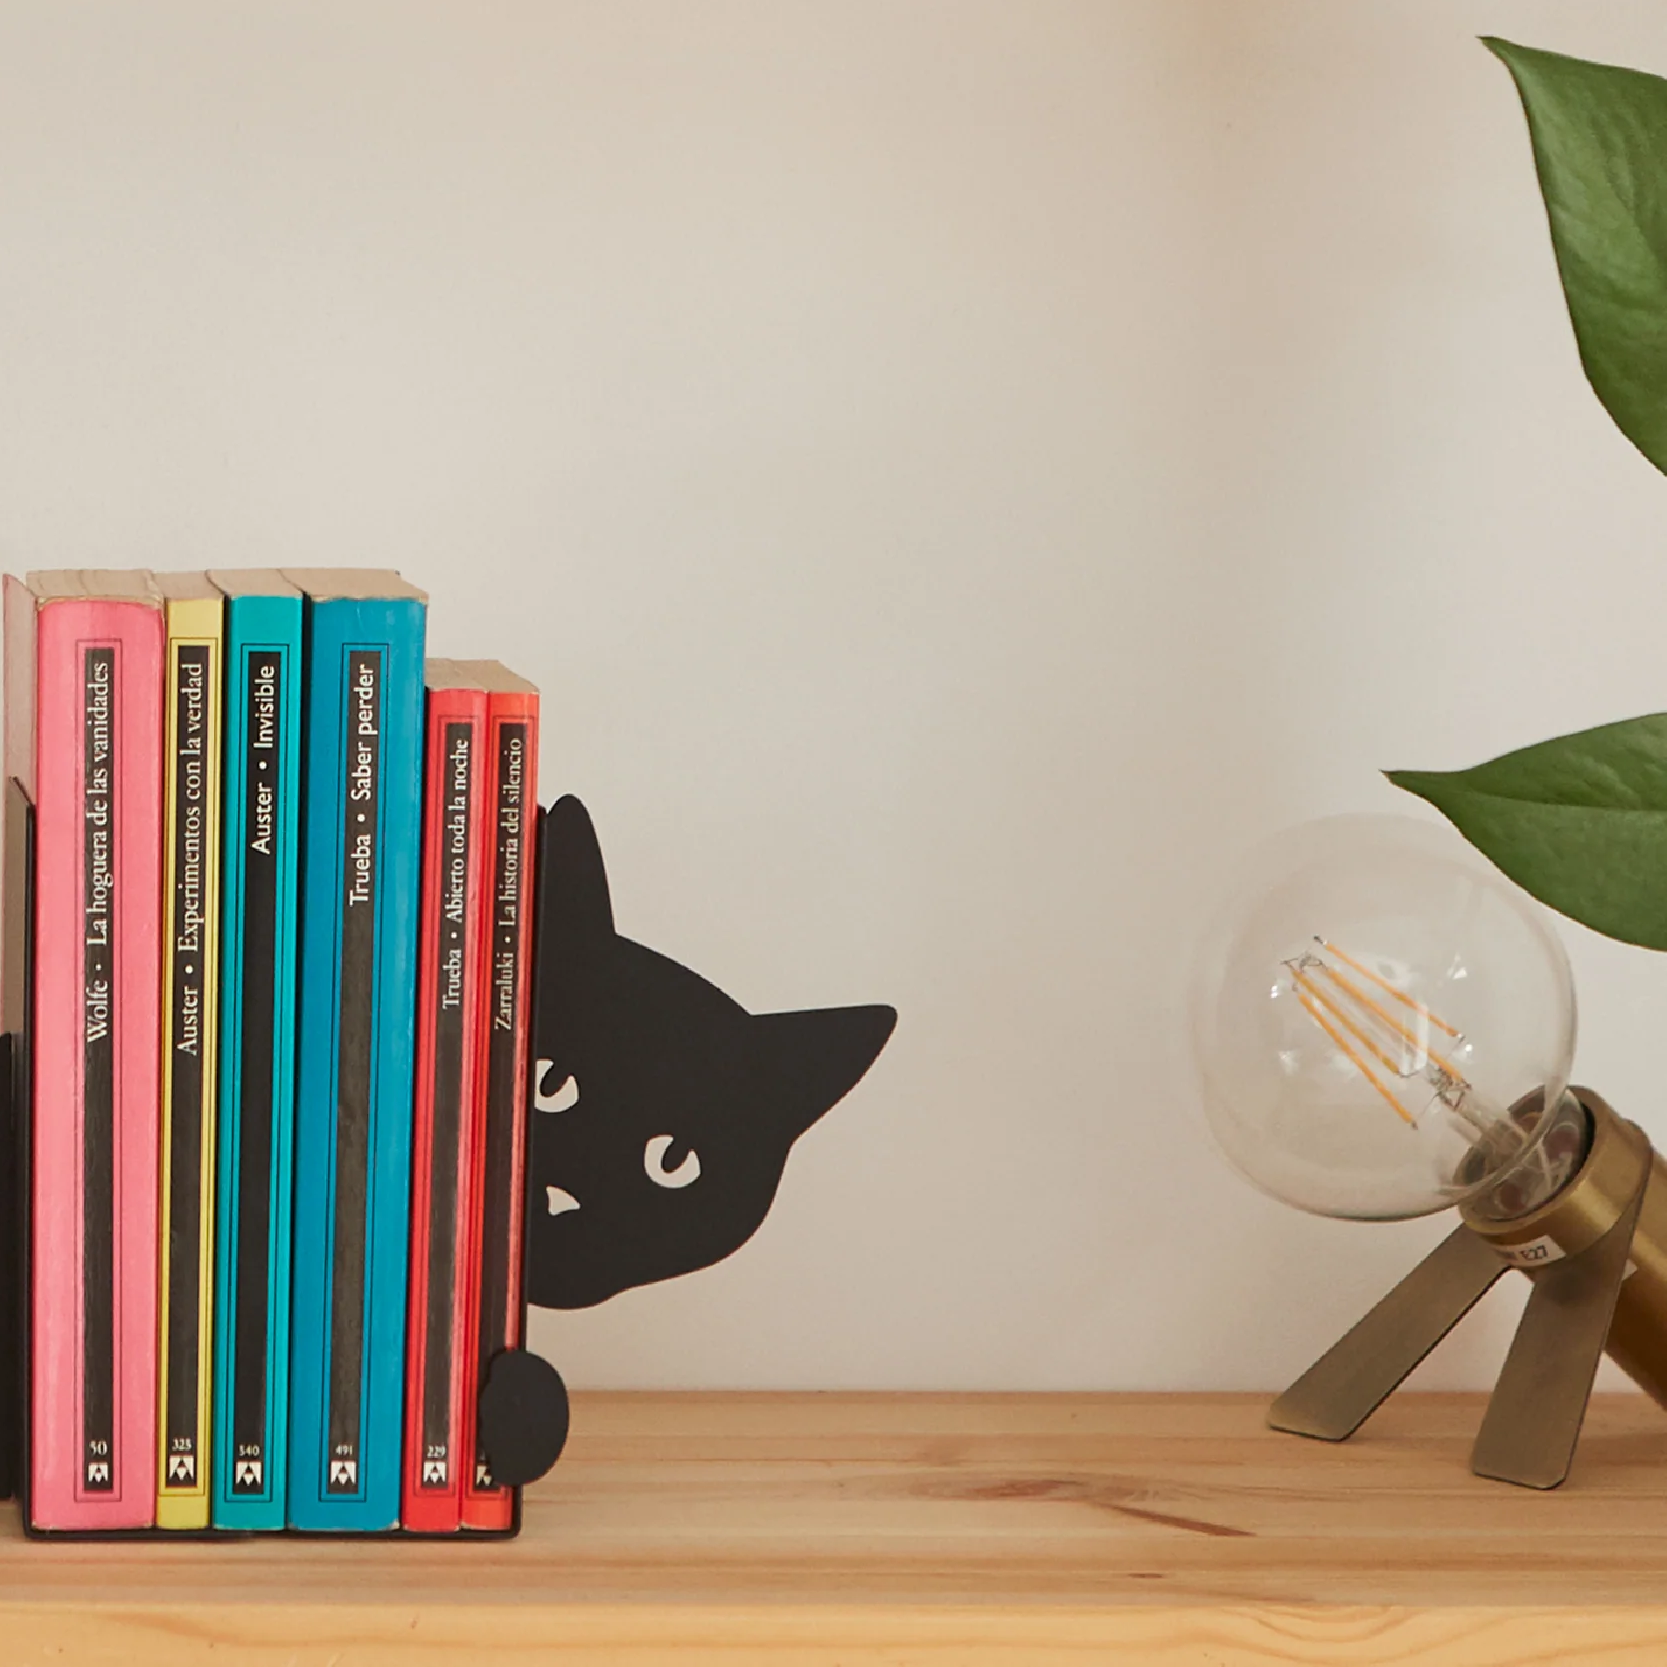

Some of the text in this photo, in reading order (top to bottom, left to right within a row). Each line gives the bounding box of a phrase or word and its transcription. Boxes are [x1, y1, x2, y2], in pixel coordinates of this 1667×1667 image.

[86, 662, 114, 1043] Wolfe La hoguera de las vanidades
[177, 663, 205, 1056] Auster Experimentos con la verdad
[251, 665, 275, 855] Auster Invisible
[349, 663, 379, 908] Trueba Saber perder
[442, 739, 470, 1010] Trueba Abierto toda la noche
[495, 738, 523, 1030] Zarraluki La historia del silencio
[89, 1439, 109, 1456] 50
[239, 1444, 260, 1457] 540
[335, 1444, 354, 1456] 491
[427, 1445, 446, 1458] 229
